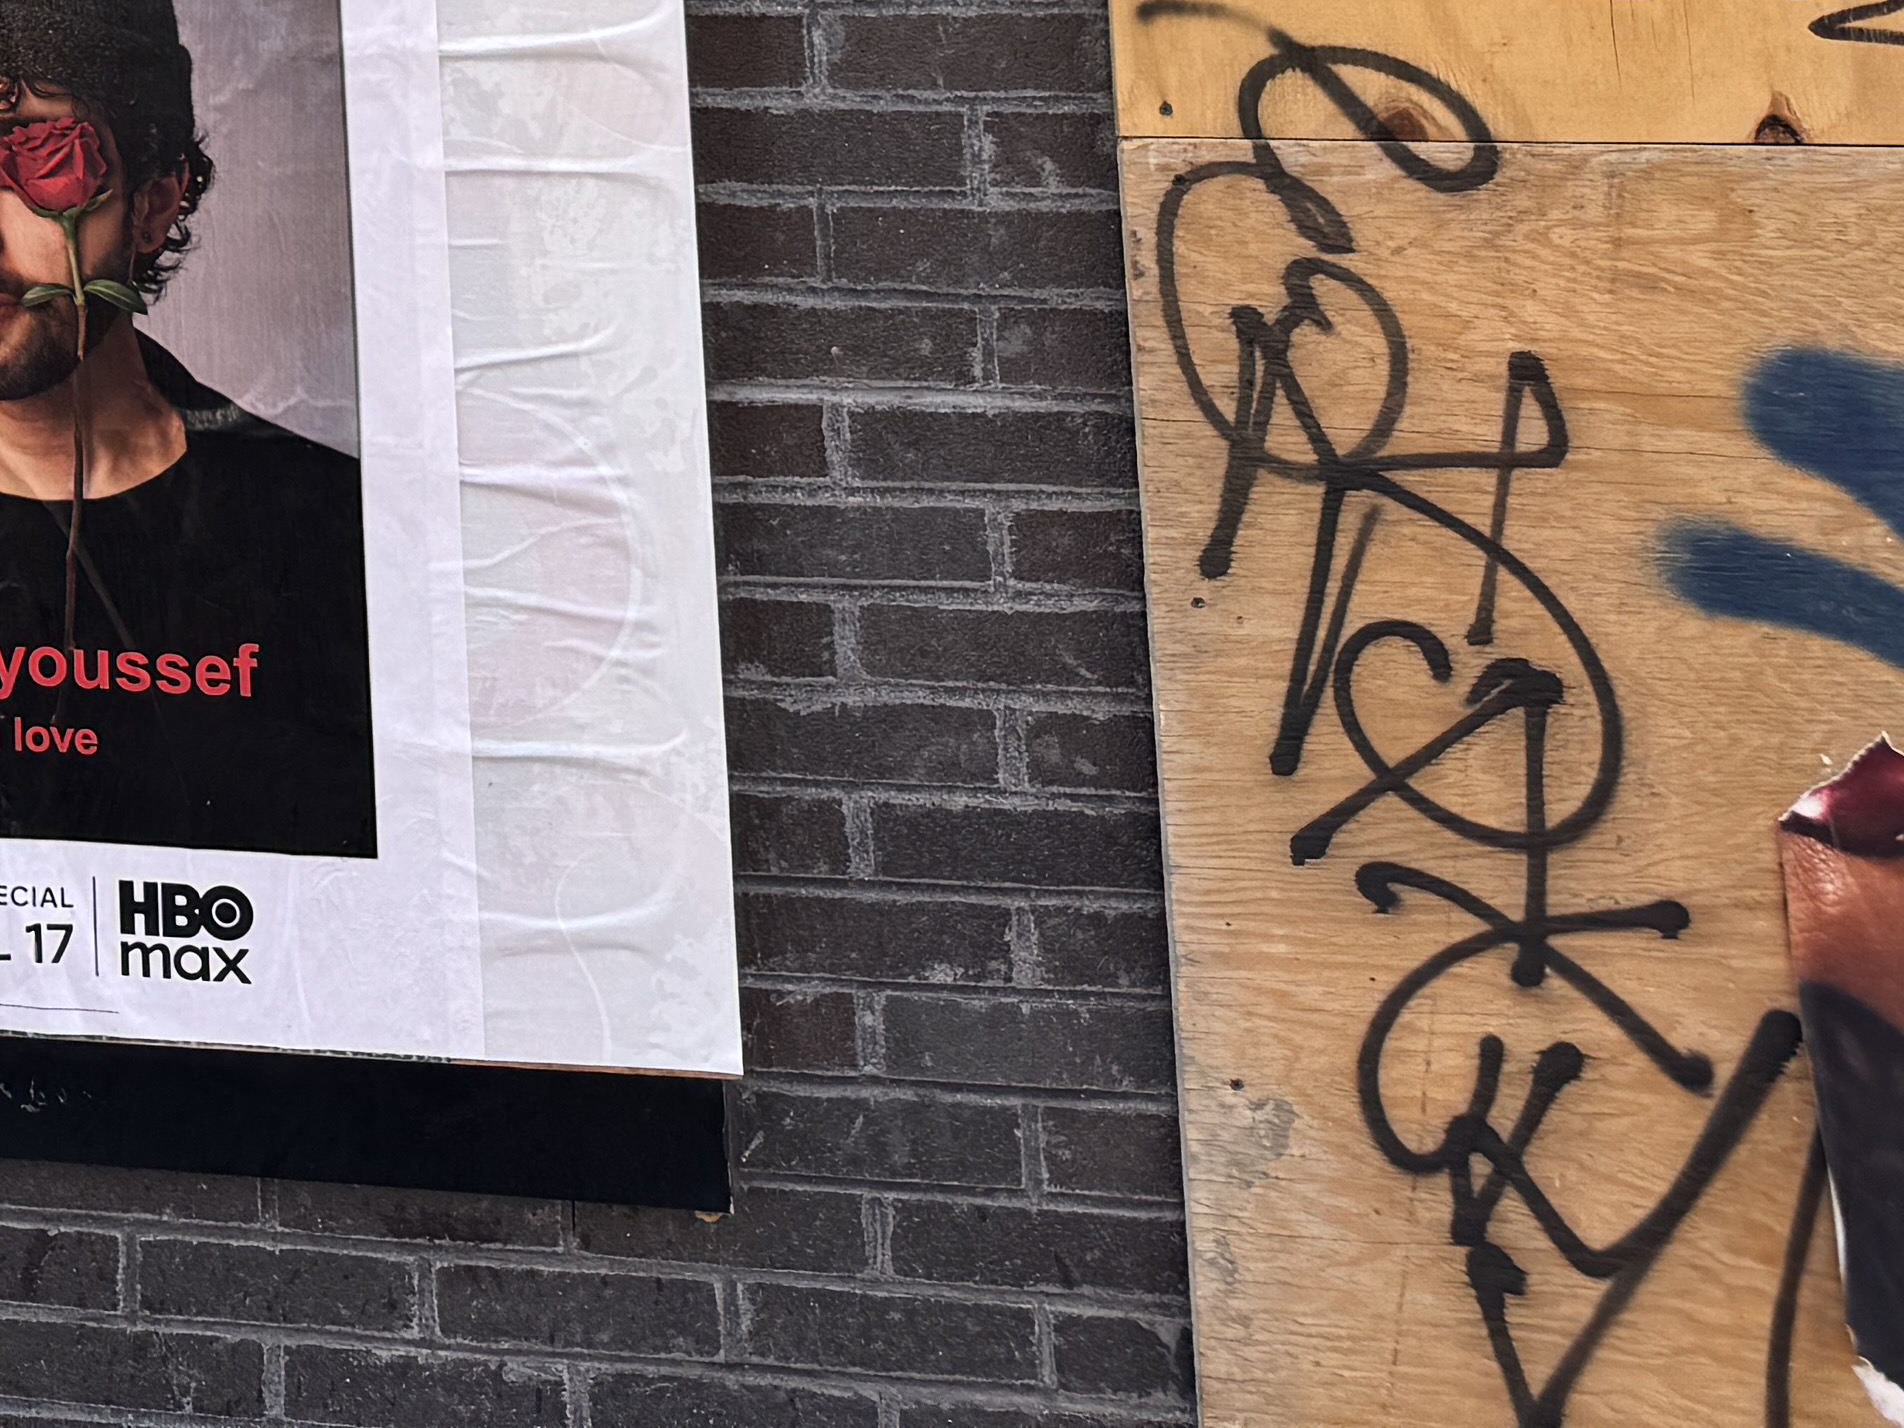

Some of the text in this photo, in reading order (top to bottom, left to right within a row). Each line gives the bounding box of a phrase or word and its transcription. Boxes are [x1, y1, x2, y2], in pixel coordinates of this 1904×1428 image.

[16, 720, 97, 754] love
[119, 880, 253, 941] HBO
[26, 923, 73, 963] 17
[121, 941, 251, 984] max
